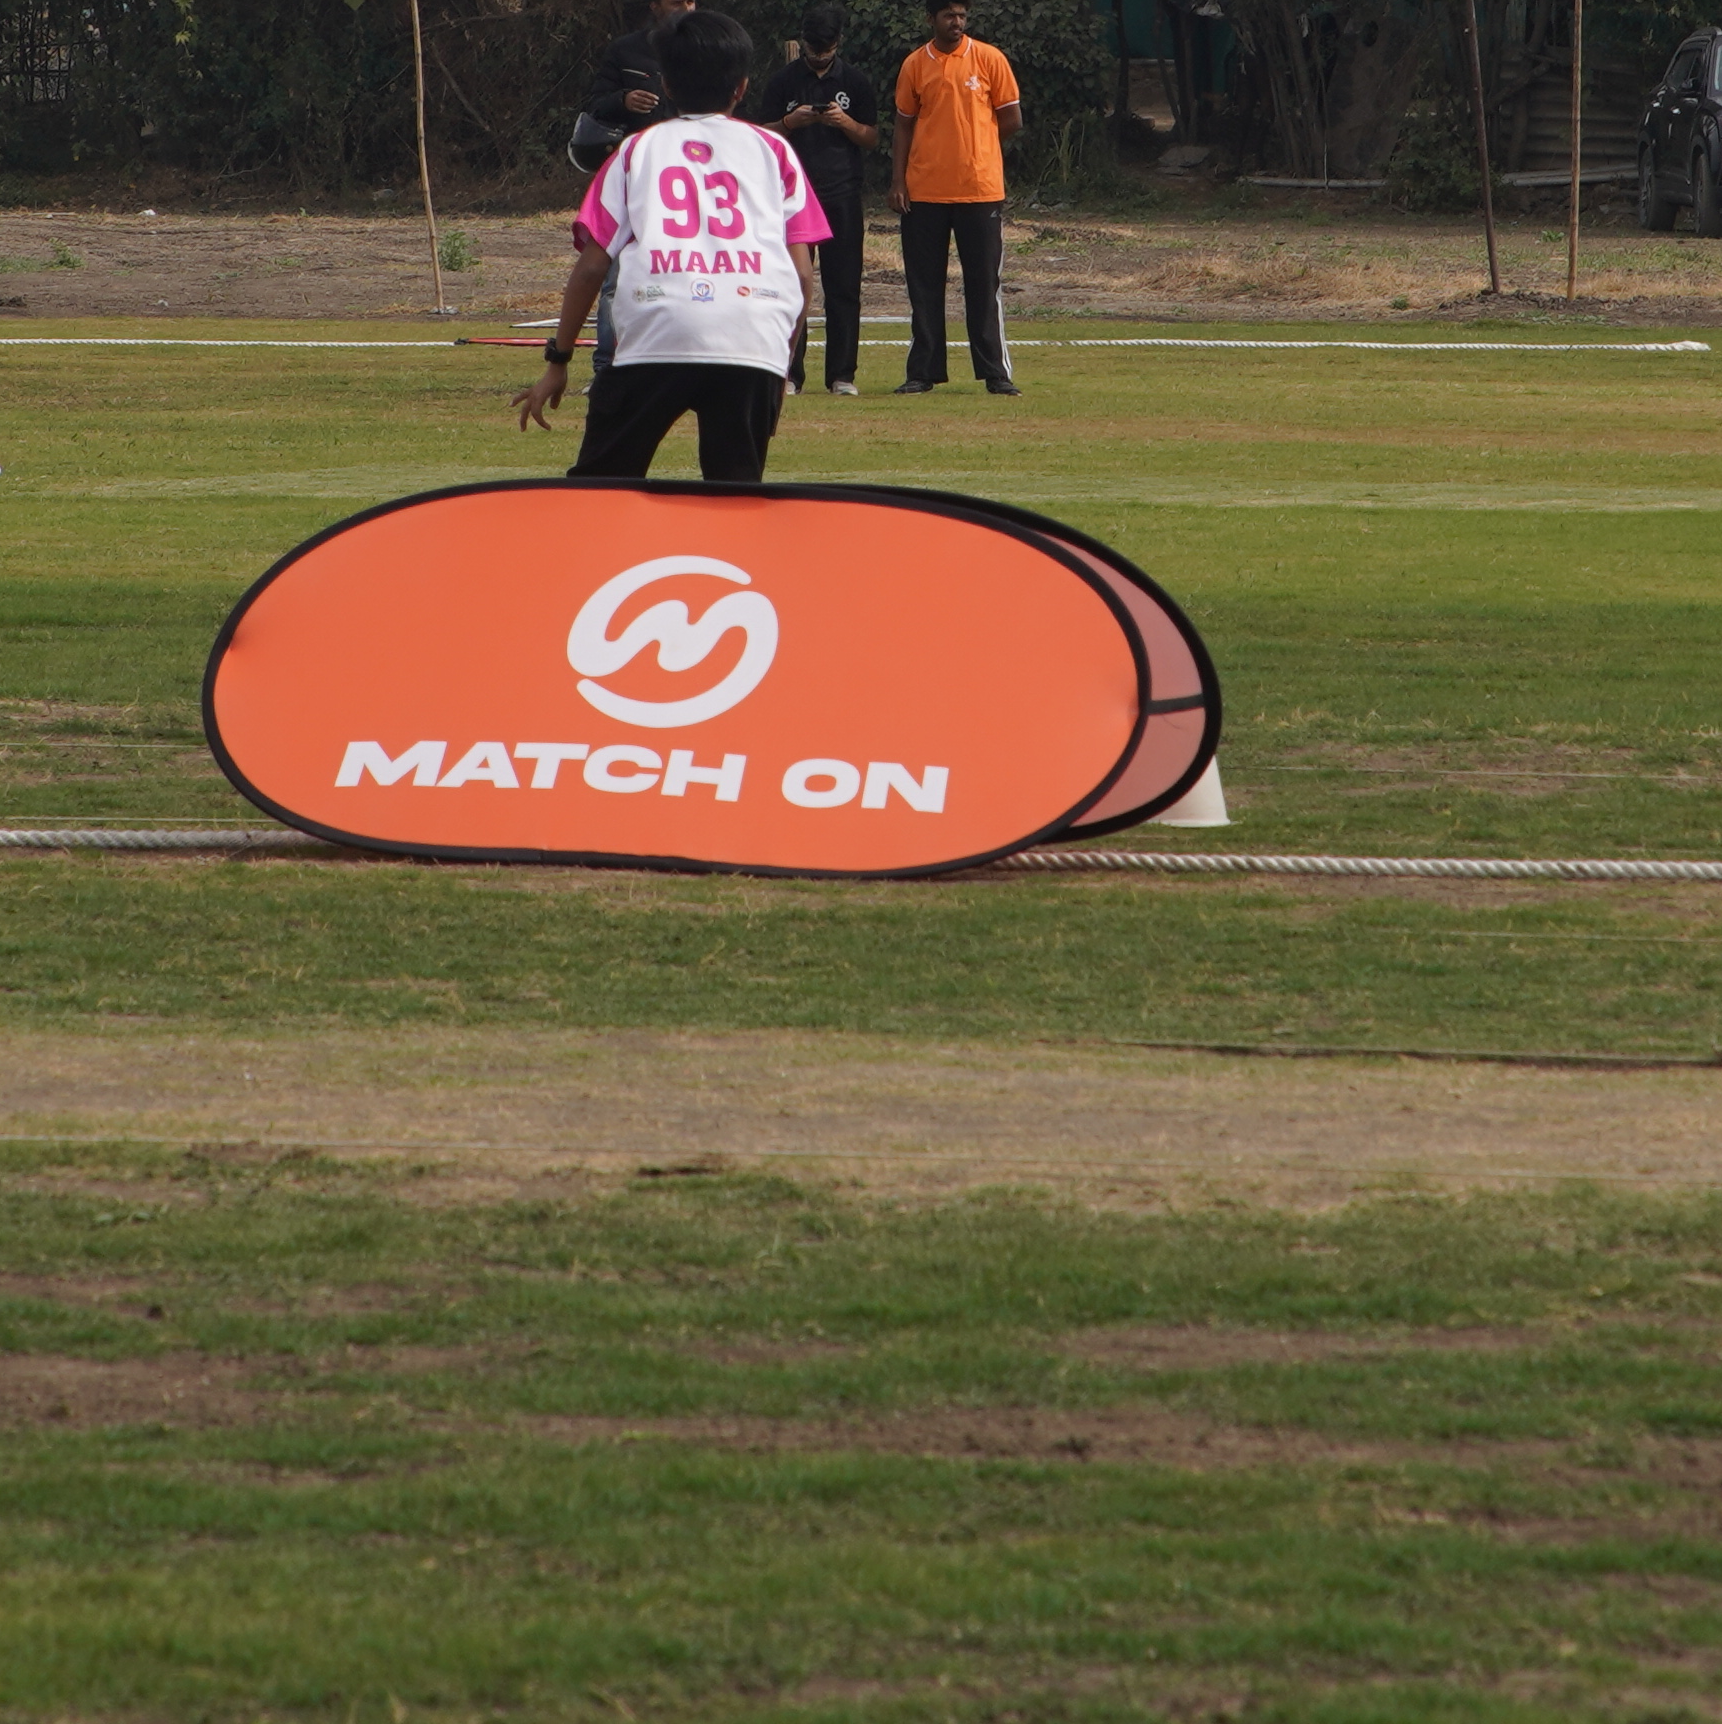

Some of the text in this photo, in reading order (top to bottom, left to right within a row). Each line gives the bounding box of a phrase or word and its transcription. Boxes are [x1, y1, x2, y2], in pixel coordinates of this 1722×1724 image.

[659, 165, 746, 240] 93
[650, 249, 762, 275] MAAN
[333, 739, 949, 814] MATCH ON
